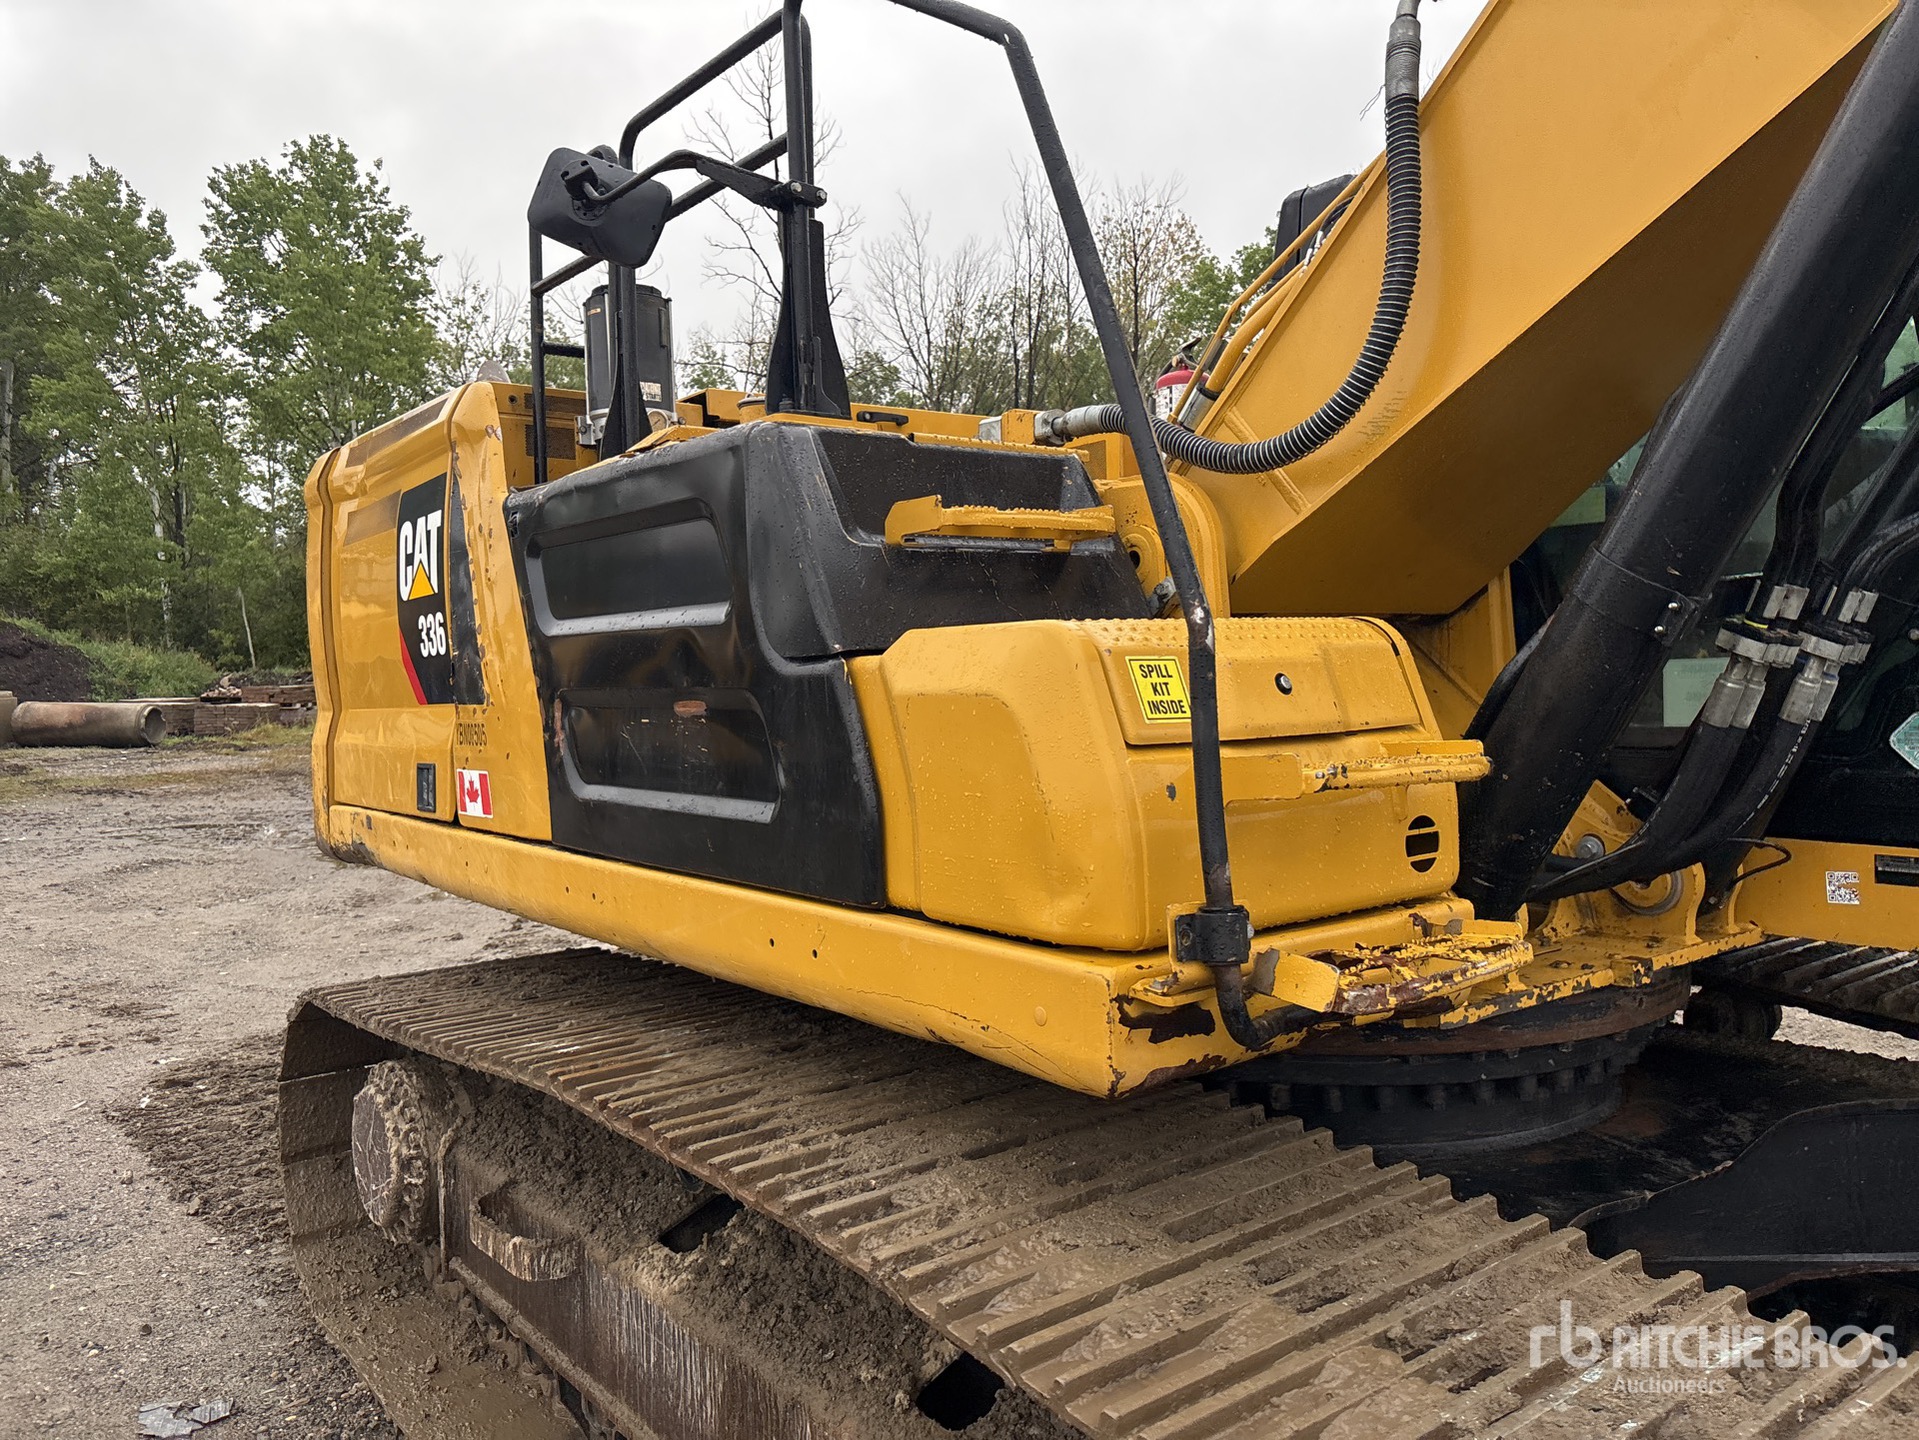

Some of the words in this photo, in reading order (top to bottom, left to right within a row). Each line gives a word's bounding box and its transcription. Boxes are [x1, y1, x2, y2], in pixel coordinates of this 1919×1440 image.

[399, 510, 442, 601] CAT
[419, 612, 447, 657] 336
[1139, 664, 1173, 678] SPILL
[1152, 682, 1171, 696] KIT
[1148, 700, 1186, 714] INSIDE
